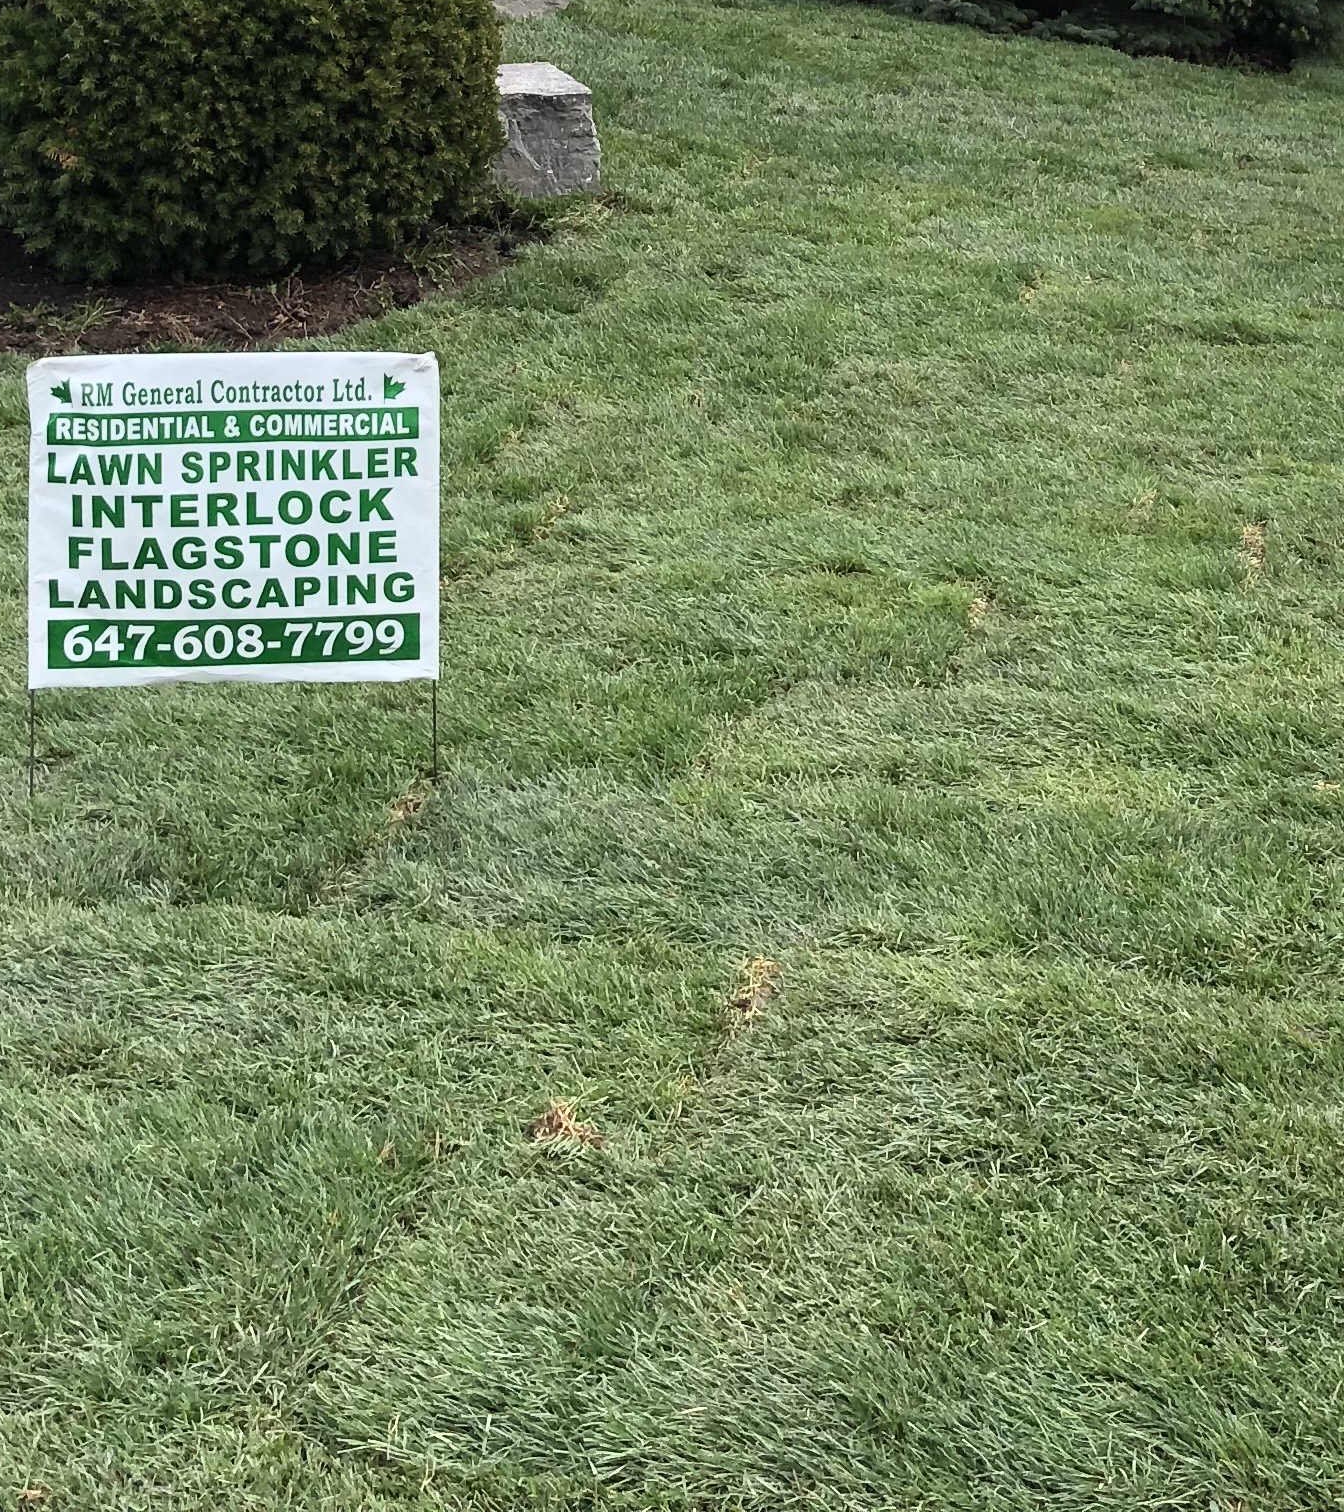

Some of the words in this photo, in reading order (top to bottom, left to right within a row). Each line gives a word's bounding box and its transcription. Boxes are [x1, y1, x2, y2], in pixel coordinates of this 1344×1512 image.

[81, 382, 114, 407] RM
[122, 378, 203, 407] General
[210, 377, 325, 404] Contractor
[332, 377, 373, 402] Ltd.
[56, 415, 215, 441] RESIDENTIAL
[224, 414, 241, 438] &
[249, 412, 410, 437] COMMERCIAL
[47, 451, 163, 485] LAWN
[181, 446, 419, 484] SPRINKLER
[72, 487, 394, 528] INTERLOCK
[68, 530, 398, 570] FLAGSTONE
[49, 571, 415, 609] LANDSCAPING
[63, 619, 405, 662] 647-608-7799
